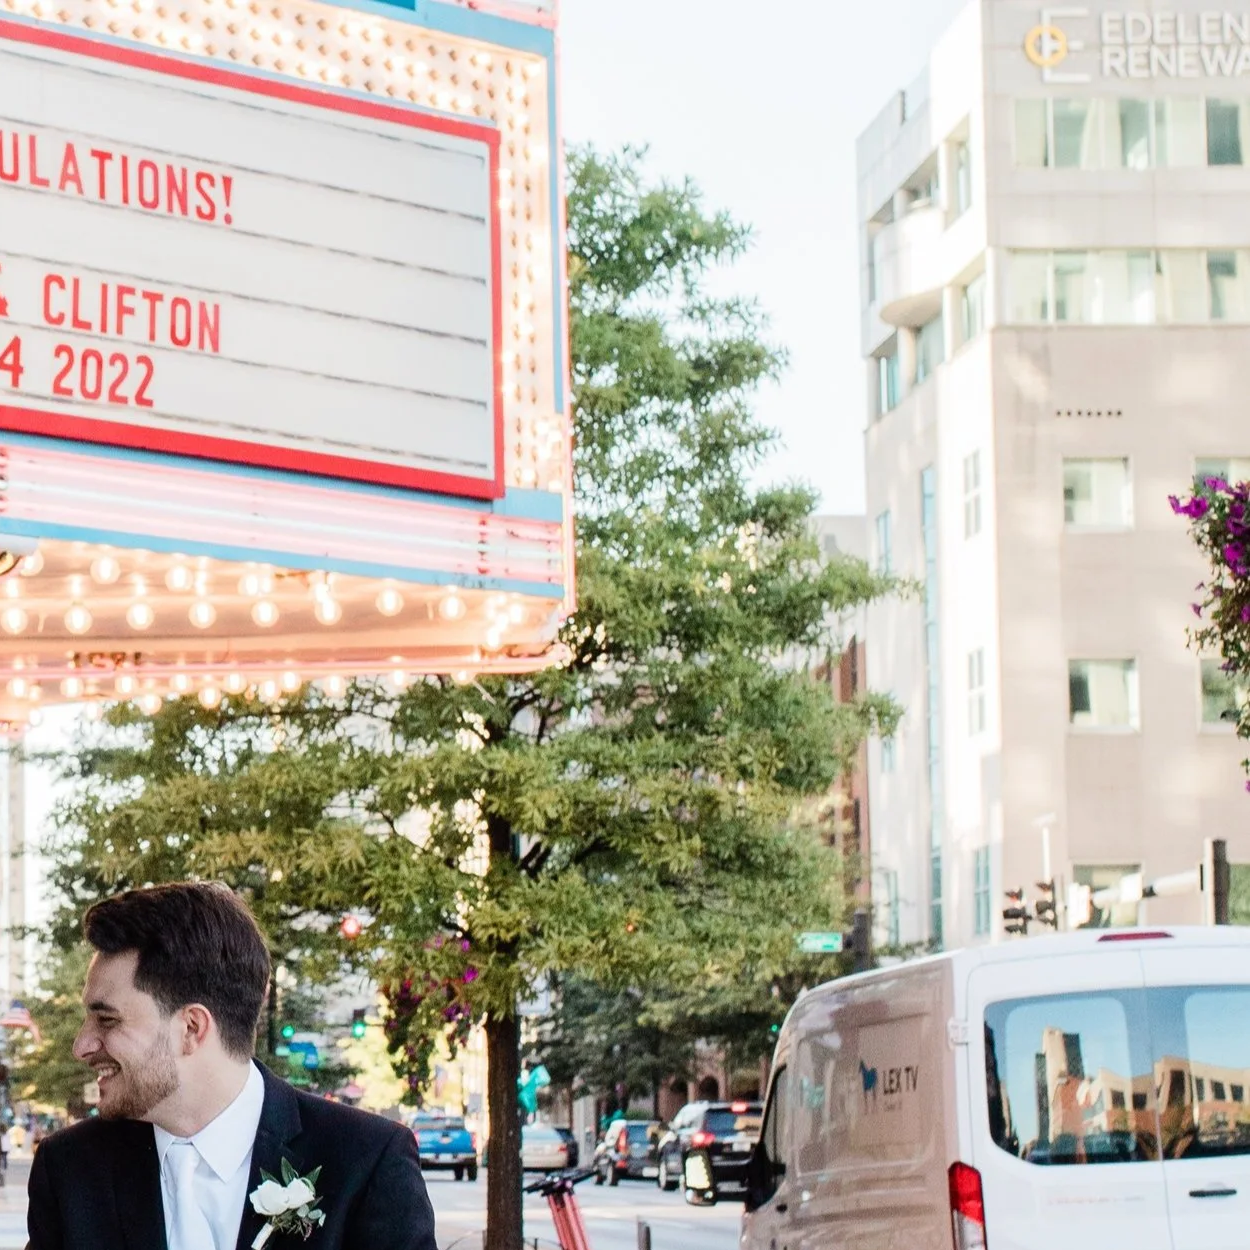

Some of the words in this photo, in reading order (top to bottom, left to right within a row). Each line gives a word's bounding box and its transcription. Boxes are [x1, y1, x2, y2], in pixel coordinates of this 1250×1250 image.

[1100, 10, 1250, 44] EDELEN
[42, 273, 221, 353] CLIFTON
[51, 343, 156, 408] 2022
[904, 1064, 919, 1092] TV
